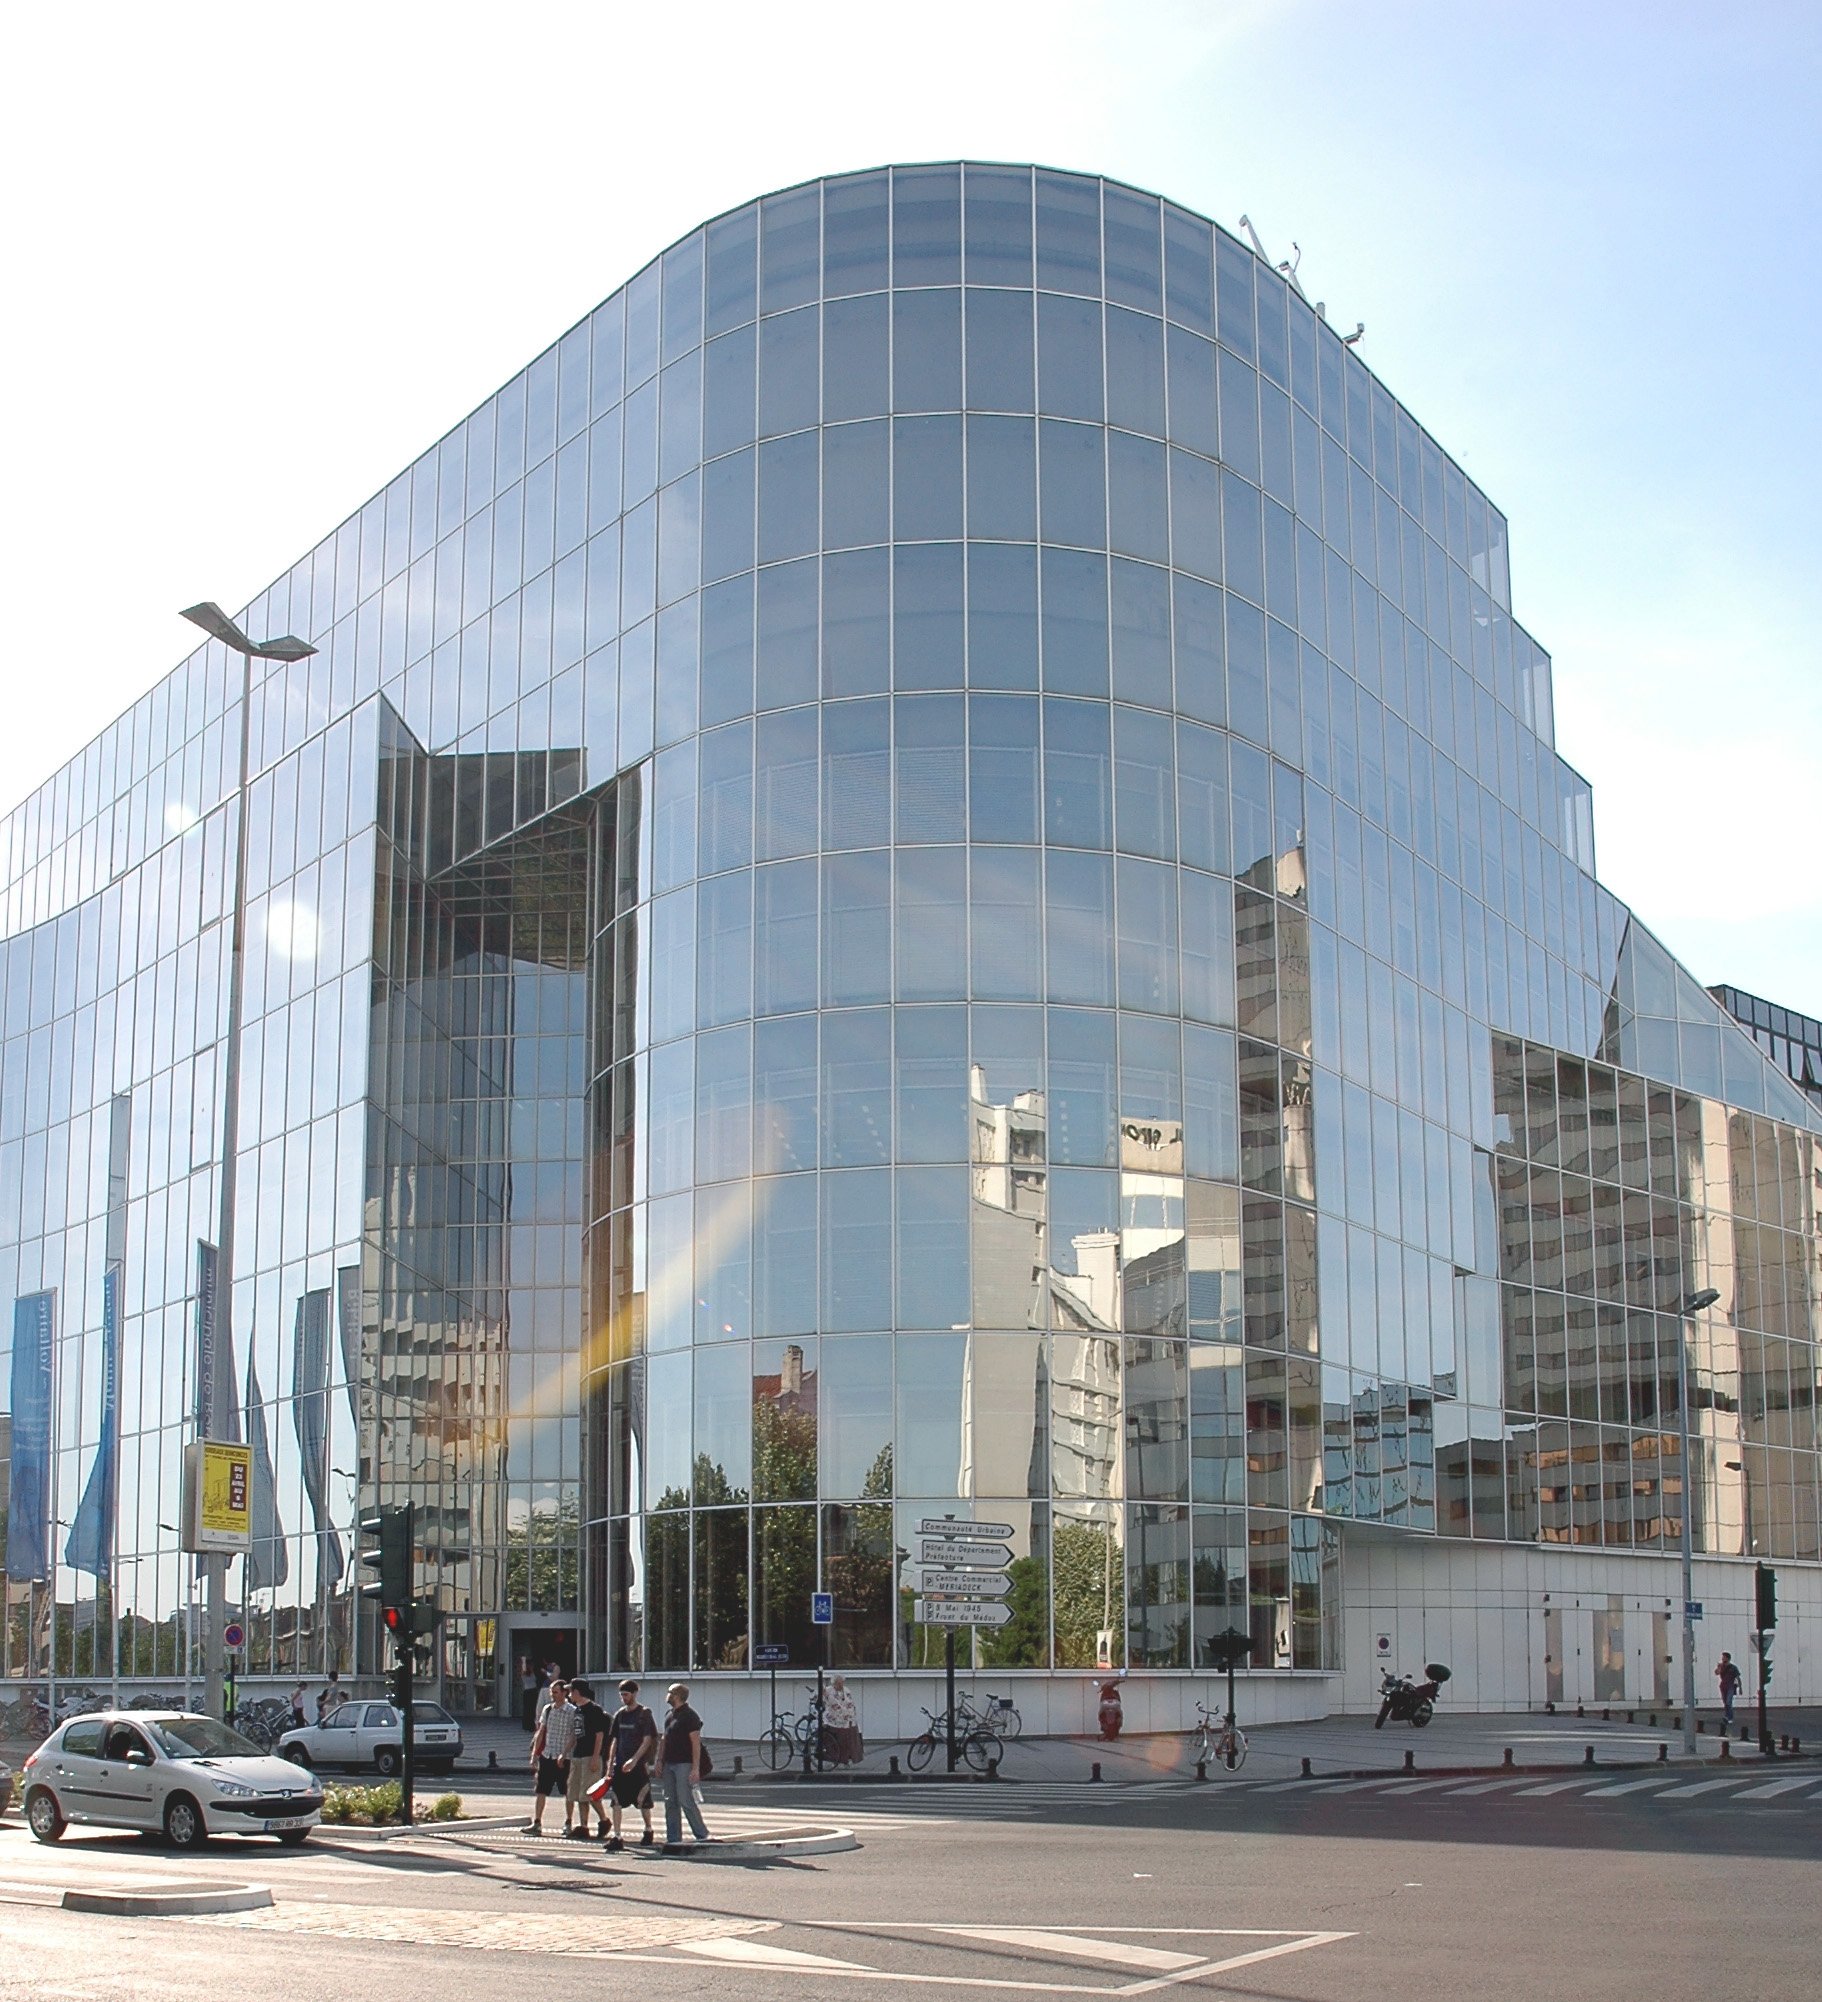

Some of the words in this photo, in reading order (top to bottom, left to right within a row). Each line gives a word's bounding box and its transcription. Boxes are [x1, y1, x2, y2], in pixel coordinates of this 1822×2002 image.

[202, 1268, 215, 1365] municipale
[203, 1371, 215, 1396] de
[925, 1522, 973, 1533] Communauté
[977, 1526, 1005, 1535] Urbaine
[925, 1543, 944, 1551] Hôtel
[947, 1544, 955, 1552] du
[958, 1545, 1001, 1555] Département
[925, 1552, 964, 1562] Préfecture
[935, 1573, 958, 1582] Centre
[962, 1574, 1002, 1583] Commercial
